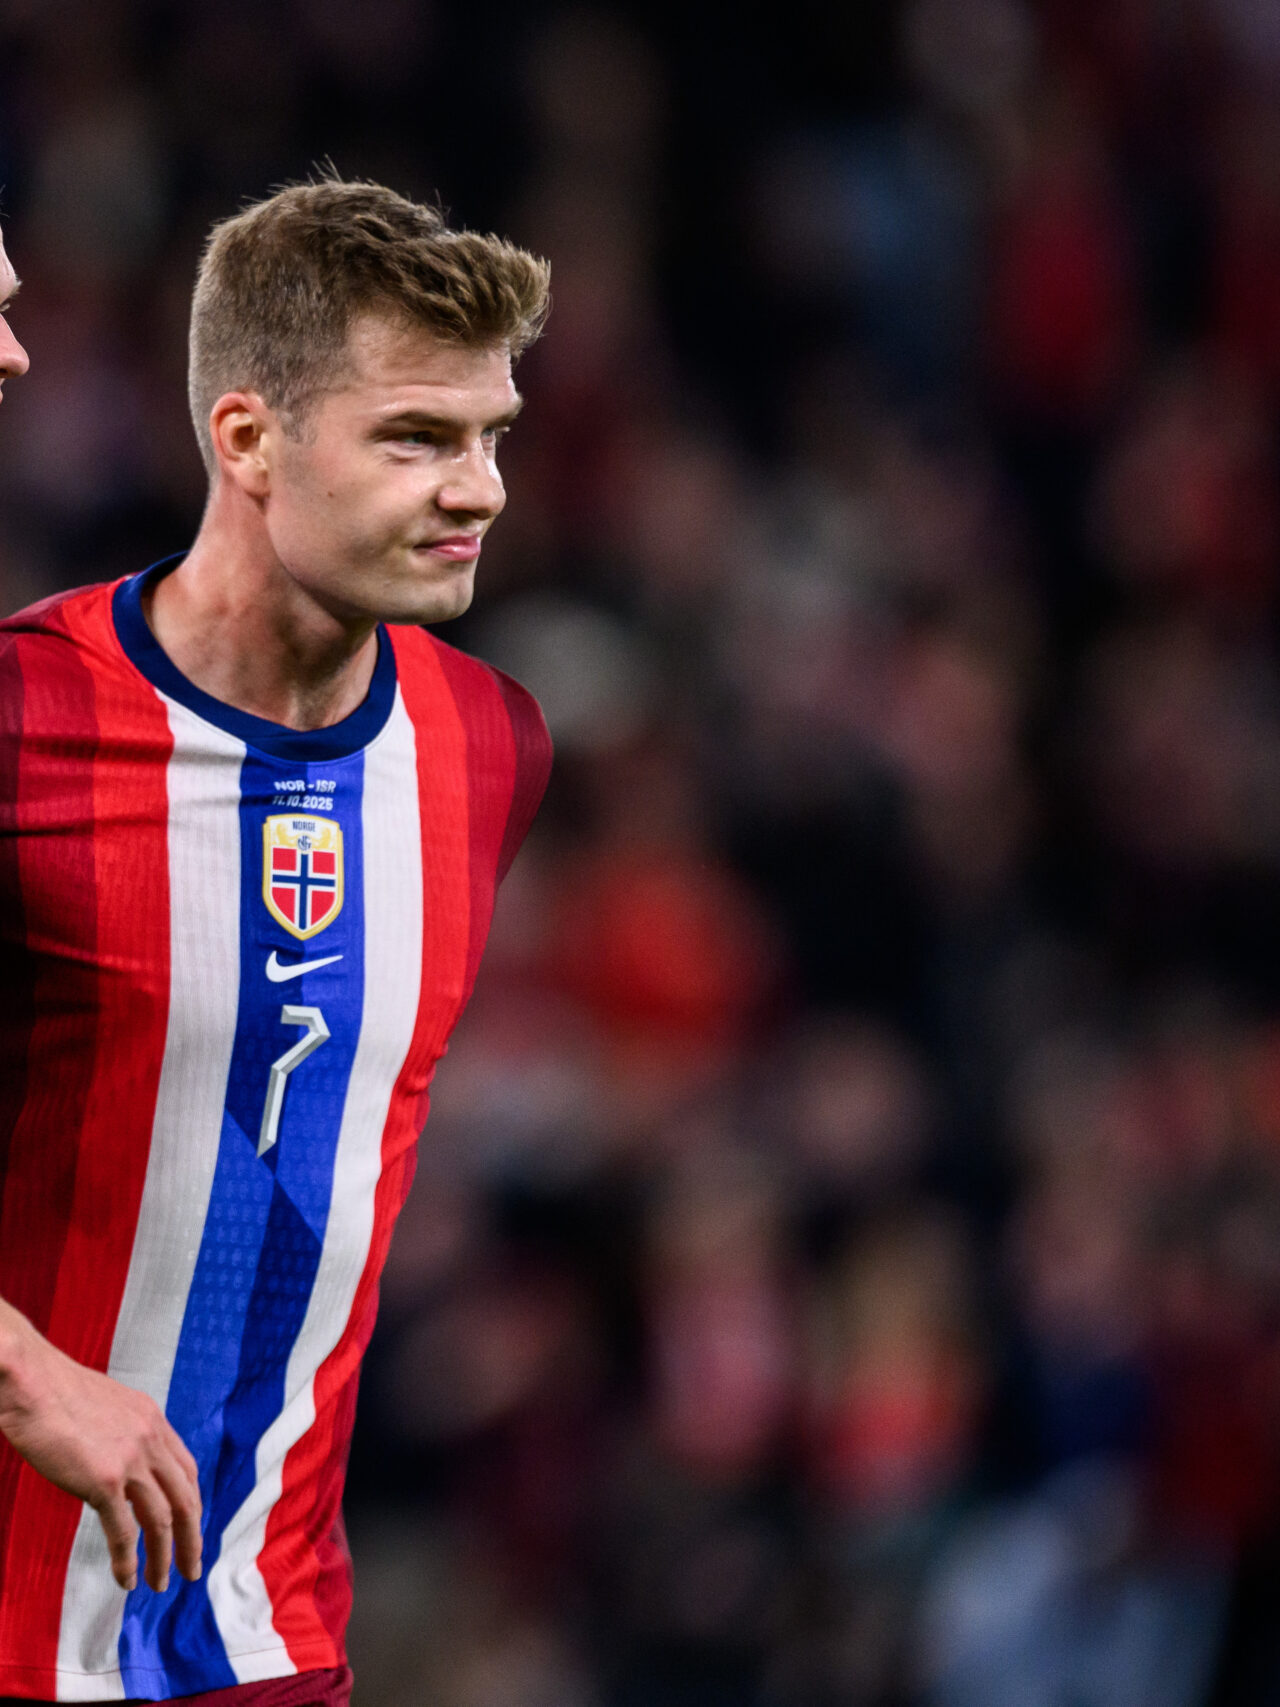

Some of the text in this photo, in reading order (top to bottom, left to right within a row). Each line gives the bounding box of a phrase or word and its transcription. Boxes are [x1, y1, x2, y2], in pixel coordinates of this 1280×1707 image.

[274, 780, 305, 791] NOR
[316, 779, 337, 793] ISR
[273, 795, 333, 811] 11.10.2025
[292, 820, 316, 833] NORGE
[256, 1004, 332, 1158] 7
